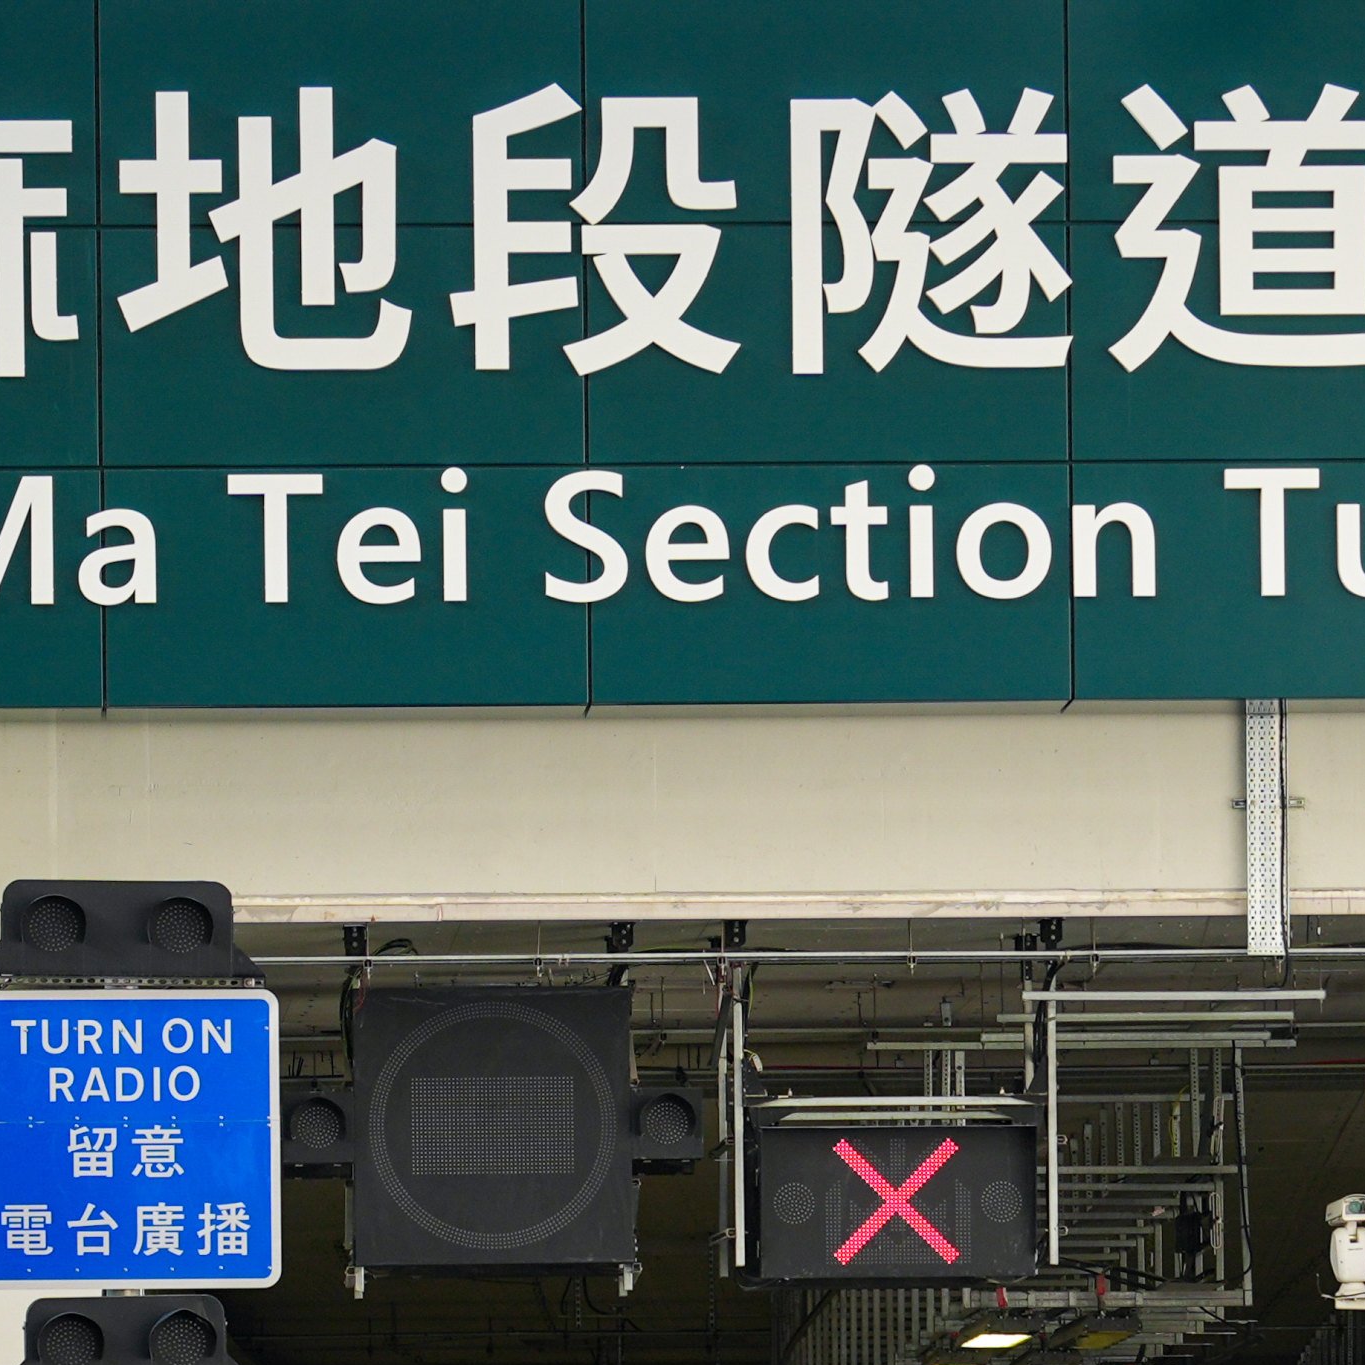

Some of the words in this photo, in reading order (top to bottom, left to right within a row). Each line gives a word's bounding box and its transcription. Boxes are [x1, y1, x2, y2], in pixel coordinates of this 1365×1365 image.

[227, 466, 471, 604] Tei
[545, 464, 1158, 606] Section
[11, 1018, 145, 1055] TURN
[161, 1017, 233, 1054] ON
[48, 1065, 201, 1103] RADIO
[67, 1125, 185, 1179] 留意
[0, 1201, 252, 1258] 電台廣播
